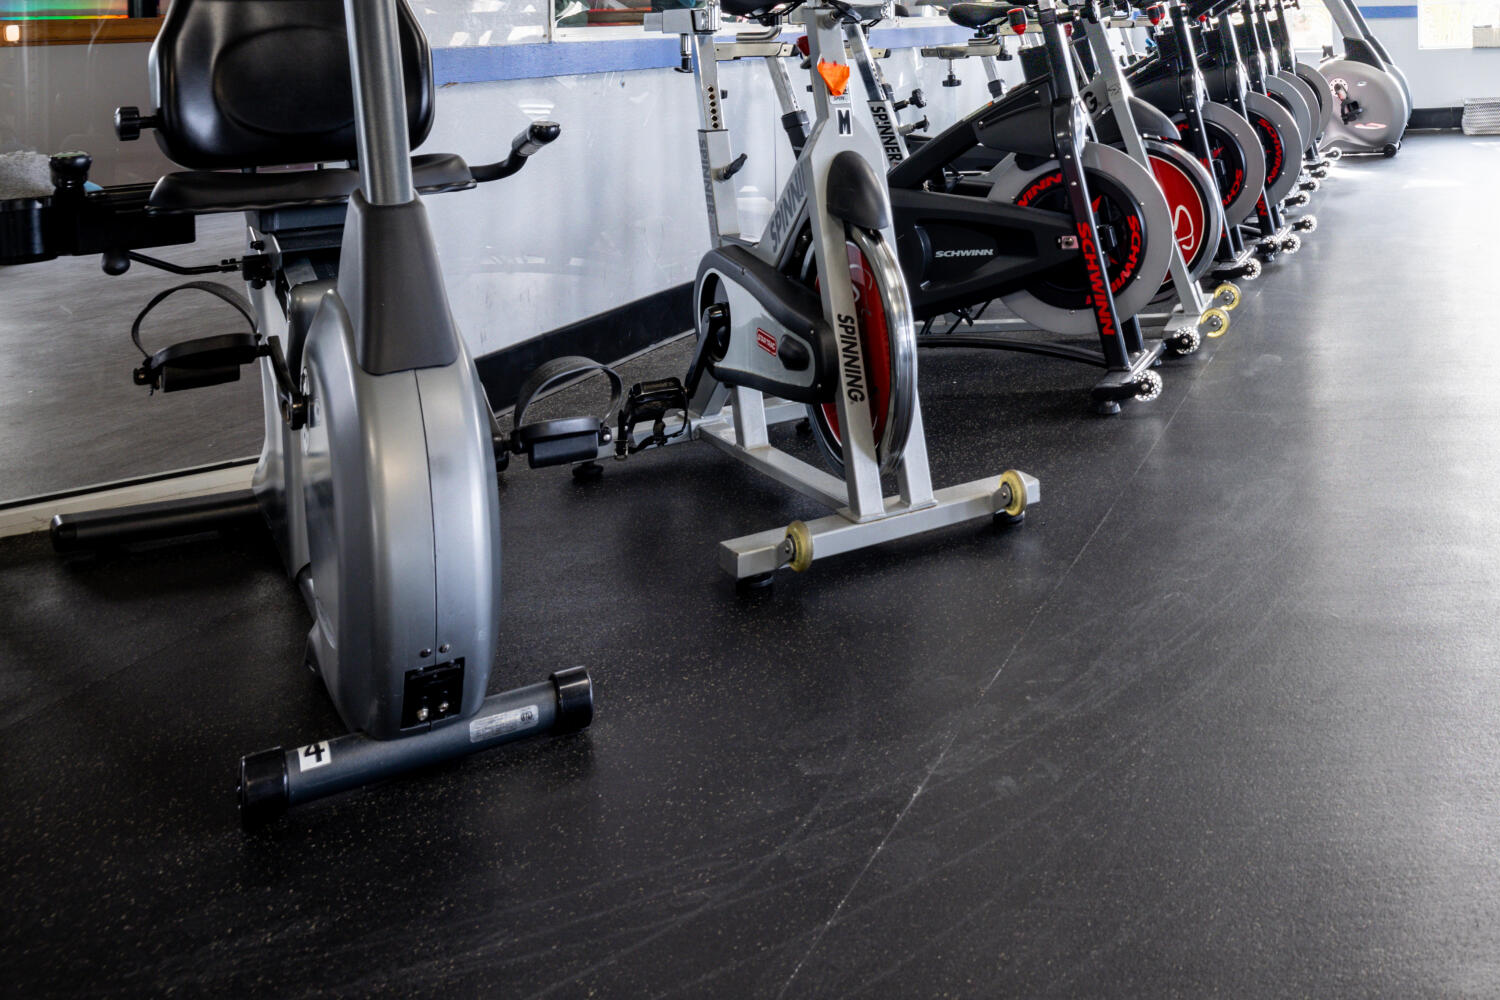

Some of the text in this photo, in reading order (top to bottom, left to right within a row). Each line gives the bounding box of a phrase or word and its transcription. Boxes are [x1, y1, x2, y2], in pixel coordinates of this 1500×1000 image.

[838, 109, 852, 135] M
[870, 105, 903, 162] SPINNER
[699, 138, 716, 216] SPINNER
[935, 248, 994, 258] SCHWINN
[1076, 221, 1116, 336] SCHWINN
[837, 313, 866, 403] SPINNING
[302, 742, 326, 763] 4
